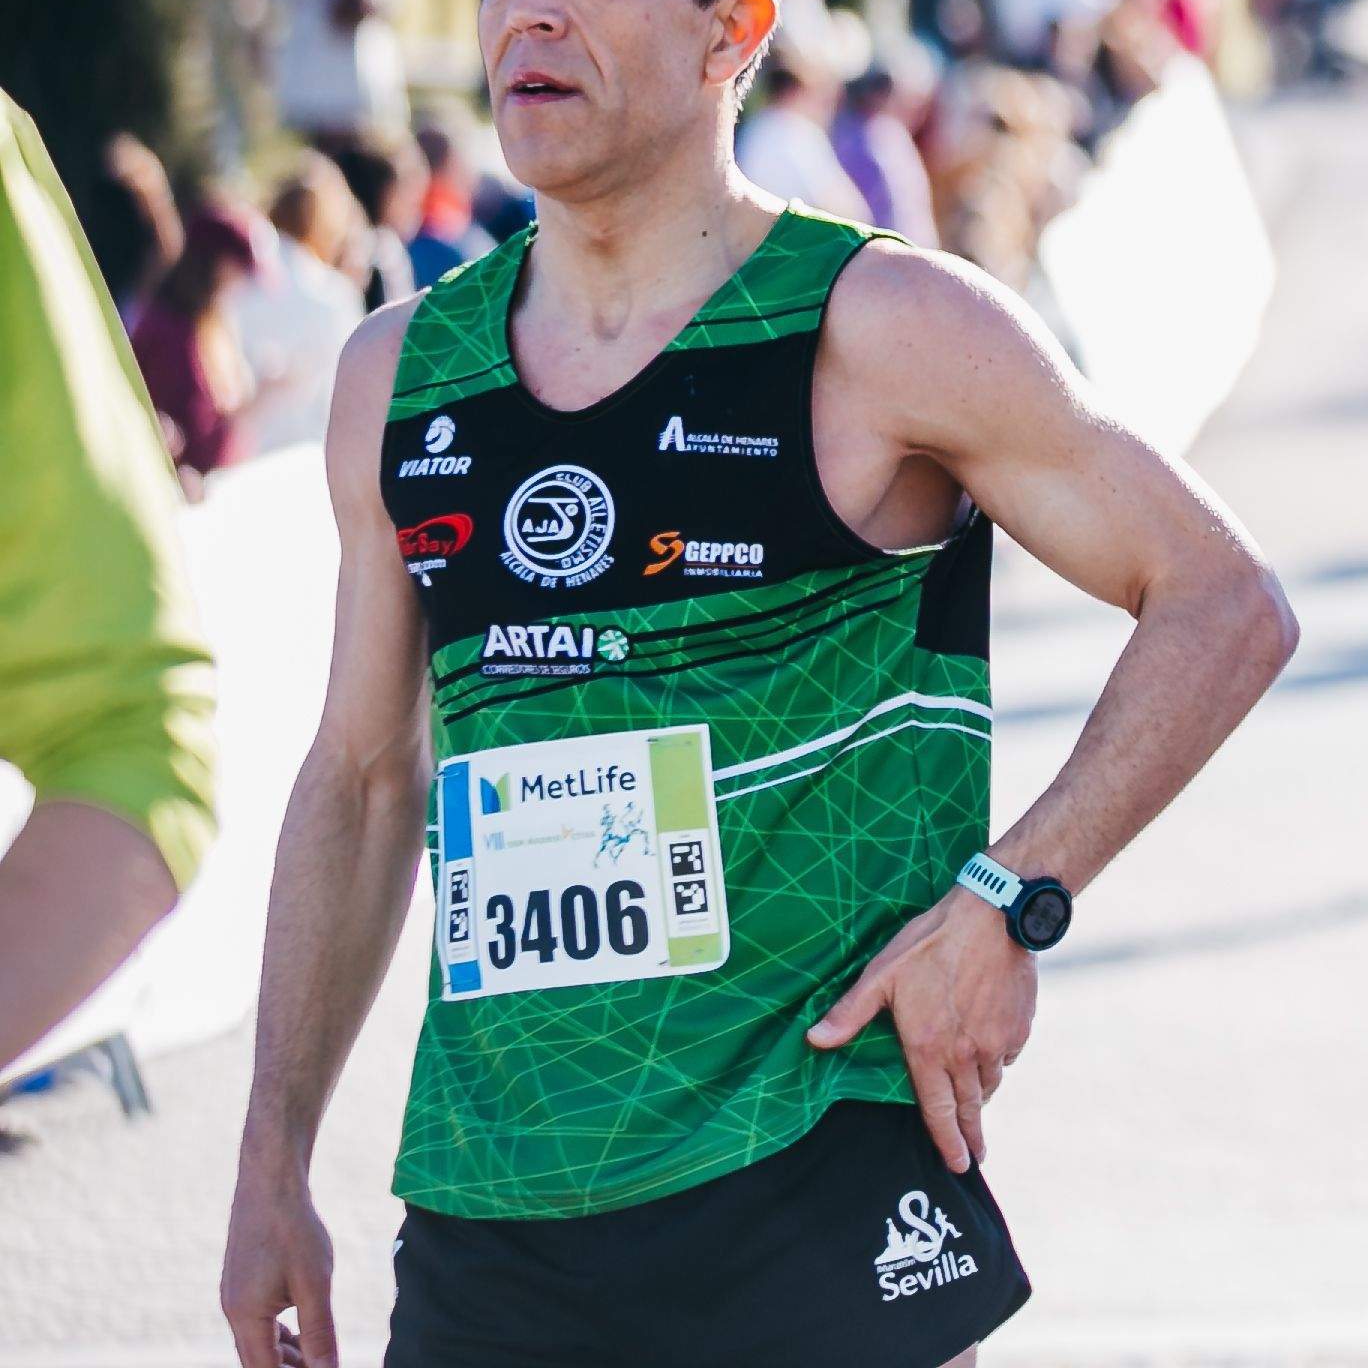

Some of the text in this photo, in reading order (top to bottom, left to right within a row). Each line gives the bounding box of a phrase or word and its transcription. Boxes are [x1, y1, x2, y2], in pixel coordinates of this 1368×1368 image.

[399, 456, 472, 478] VIATOR
[684, 540, 764, 565] GEPPCO
[482, 624, 594, 658] ARTAI
[519, 764, 637, 803] MetLife
[485, 879, 650, 970] 3406
[878, 1250, 979, 1302] Sevilla
